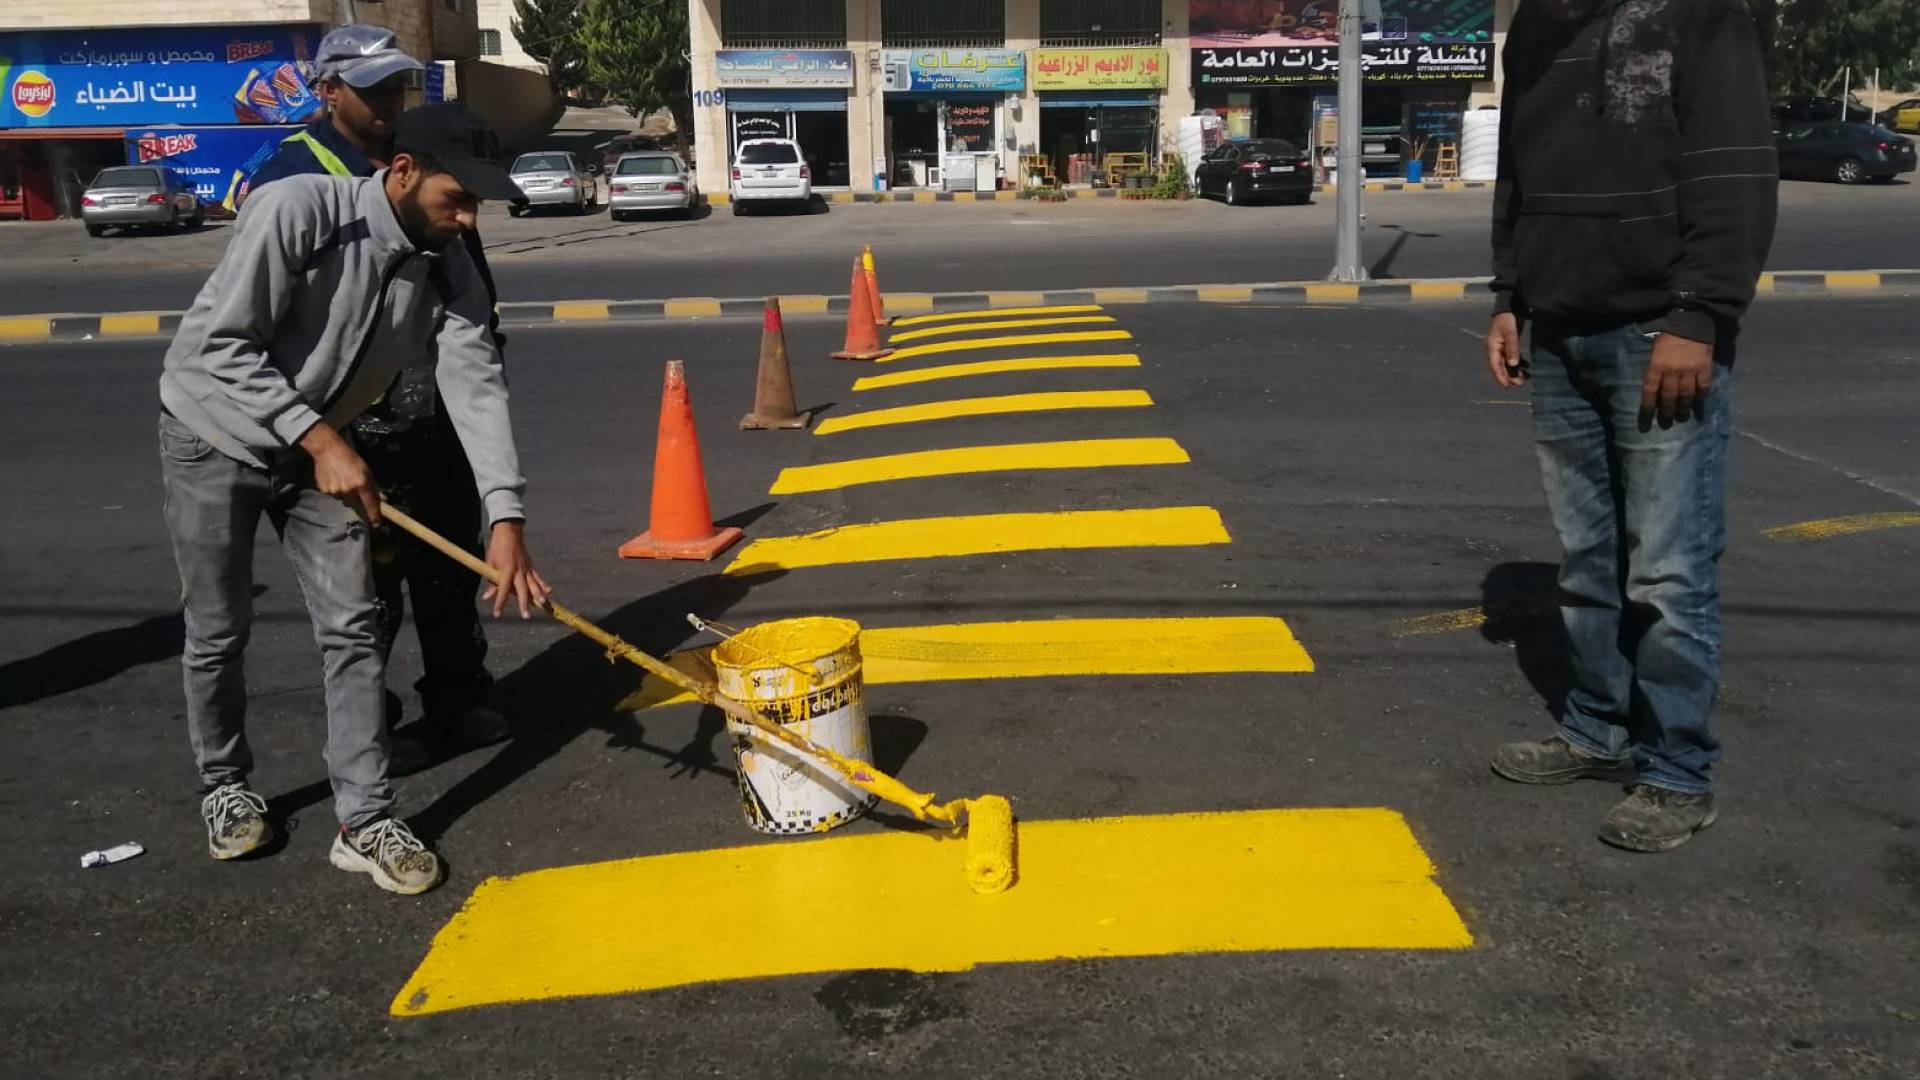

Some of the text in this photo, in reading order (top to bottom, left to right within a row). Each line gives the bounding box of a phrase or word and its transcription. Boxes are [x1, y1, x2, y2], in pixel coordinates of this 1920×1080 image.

[58, 49, 143, 67] سوبرماركت
[159, 49, 215, 65] محمص
[917, 50, 1021, 73] عرفات
[1201, 49, 1276, 67] العامة
[1416, 46, 1486, 64] المسلة
[719, 59, 773, 72] للمساحة
[1038, 54, 1090, 76] الزراعية
[1138, 53, 1160, 76] نور
[75, 81, 198, 110] بيت الضياء
[694, 90, 724, 107] 109
[138, 133, 197, 163] BREAK
